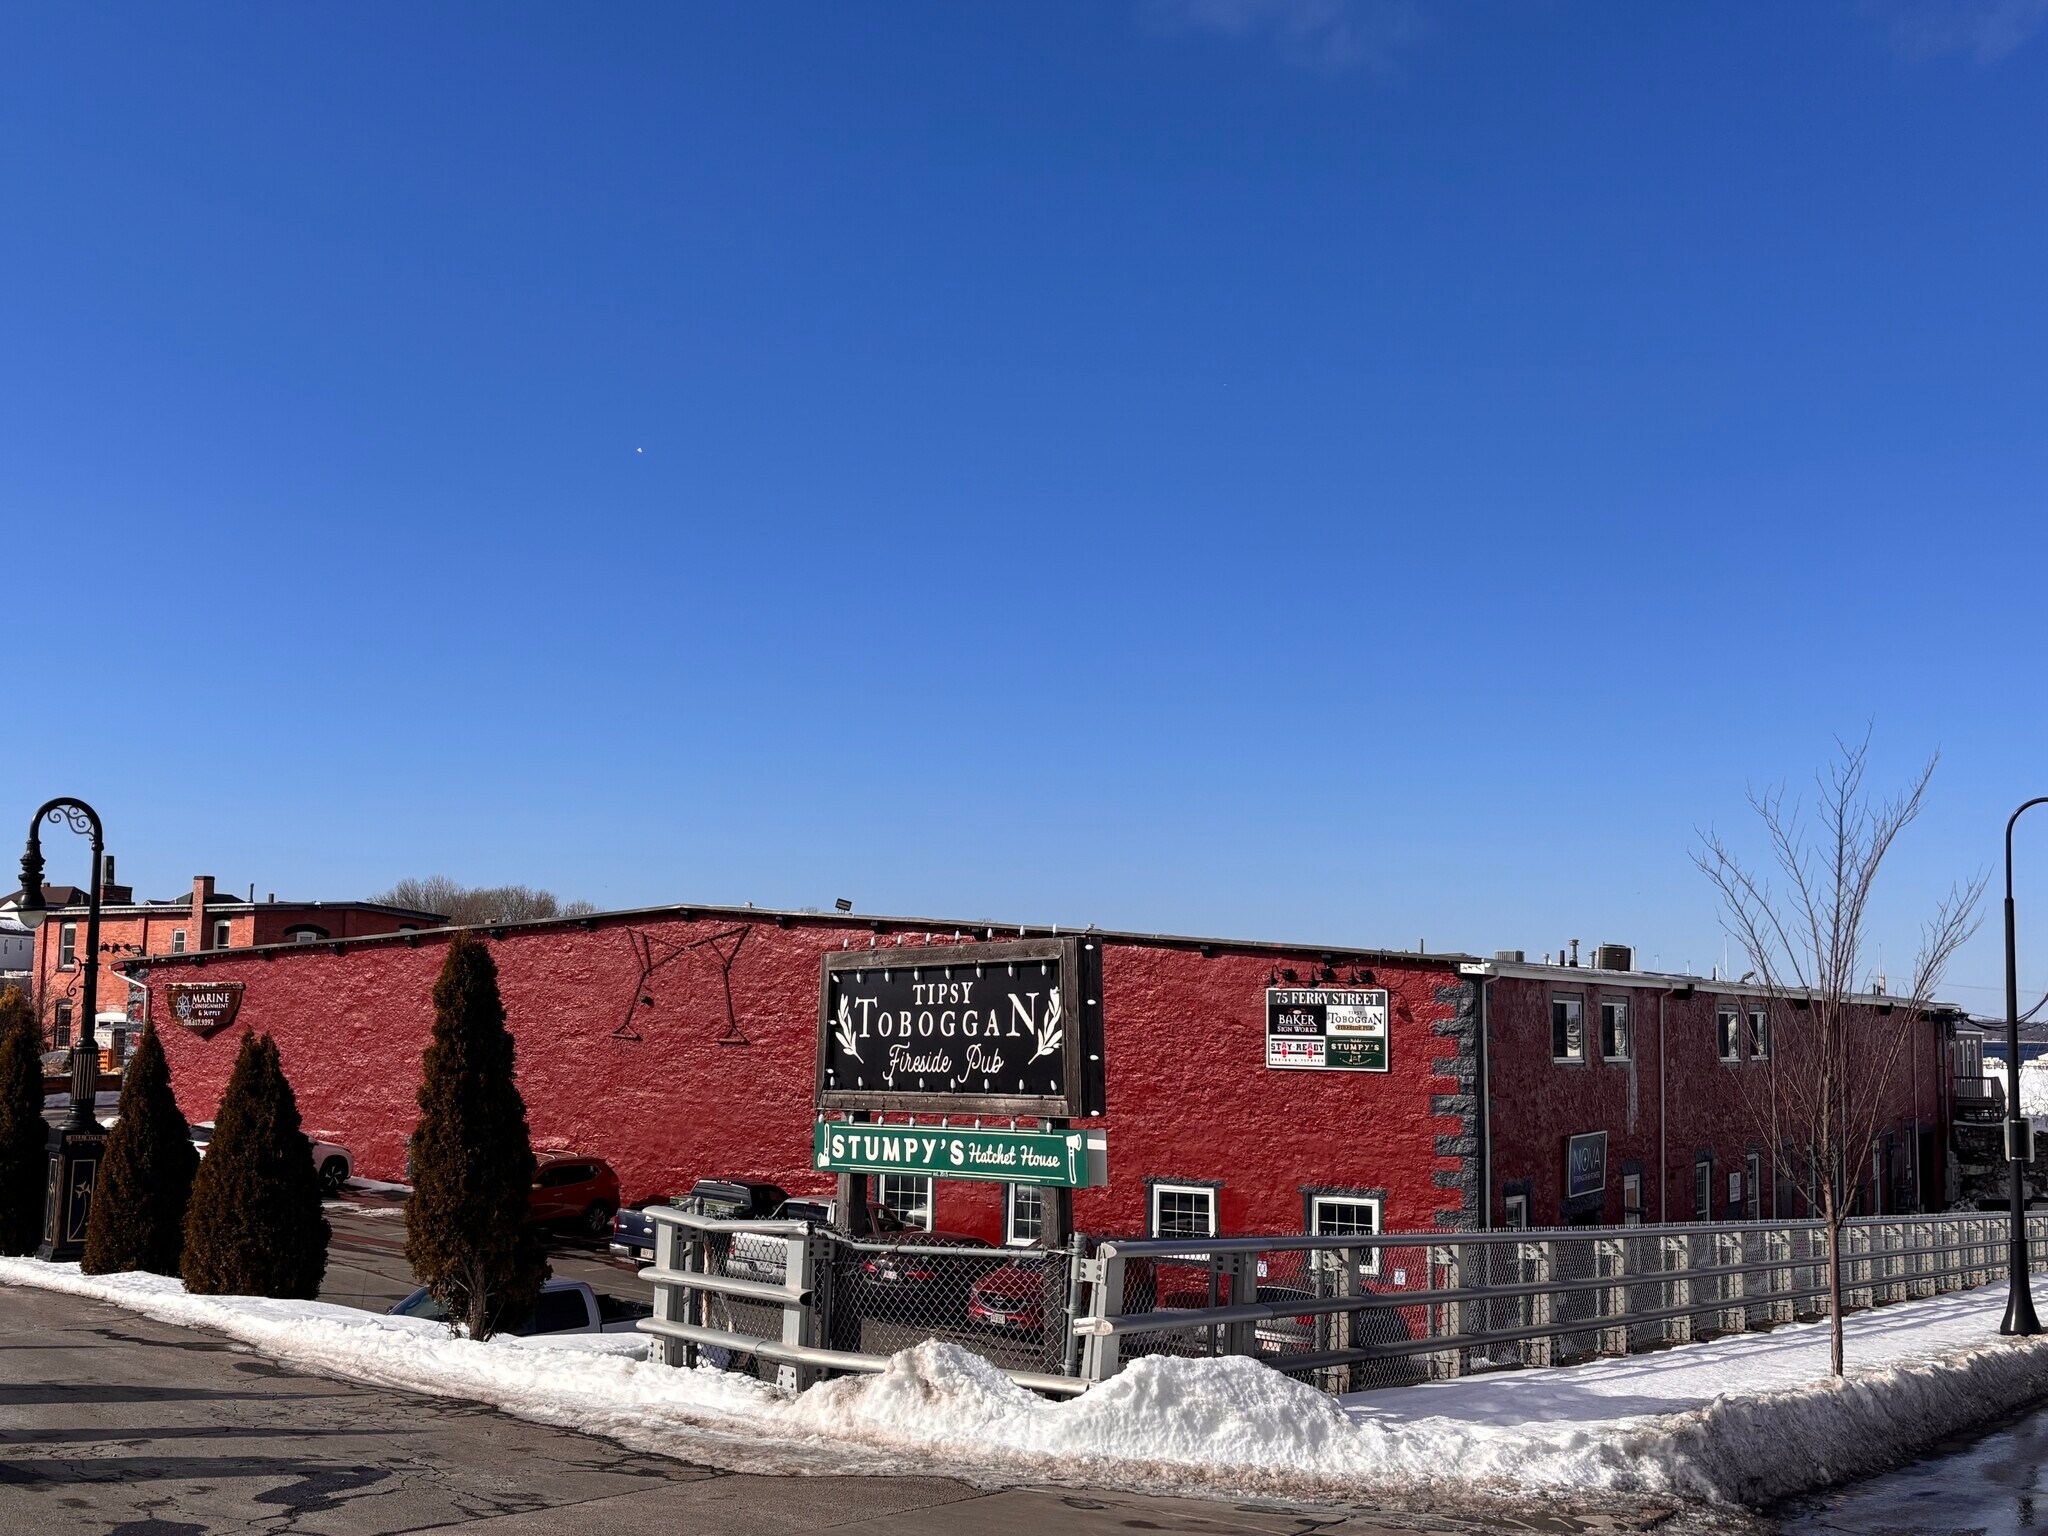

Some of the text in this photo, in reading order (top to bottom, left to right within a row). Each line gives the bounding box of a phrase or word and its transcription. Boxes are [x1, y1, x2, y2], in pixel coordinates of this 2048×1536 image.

[192, 993, 230, 1003] MARINE
[912, 981, 974, 1006] TIPSY
[1276, 992, 1379, 1005] 75 FERRY STREET
[1278, 1014, 1318, 1027] BAKER
[1296, 1042, 1324, 1051] READY
[1331, 1043, 1380, 1052] STUMPY'S
[882, 1041, 1006, 1083] Fireside Pub
[832, 1134, 1060, 1168] STUMPY'S Hatchet House
[1574, 1146, 1601, 1173] NOVA
